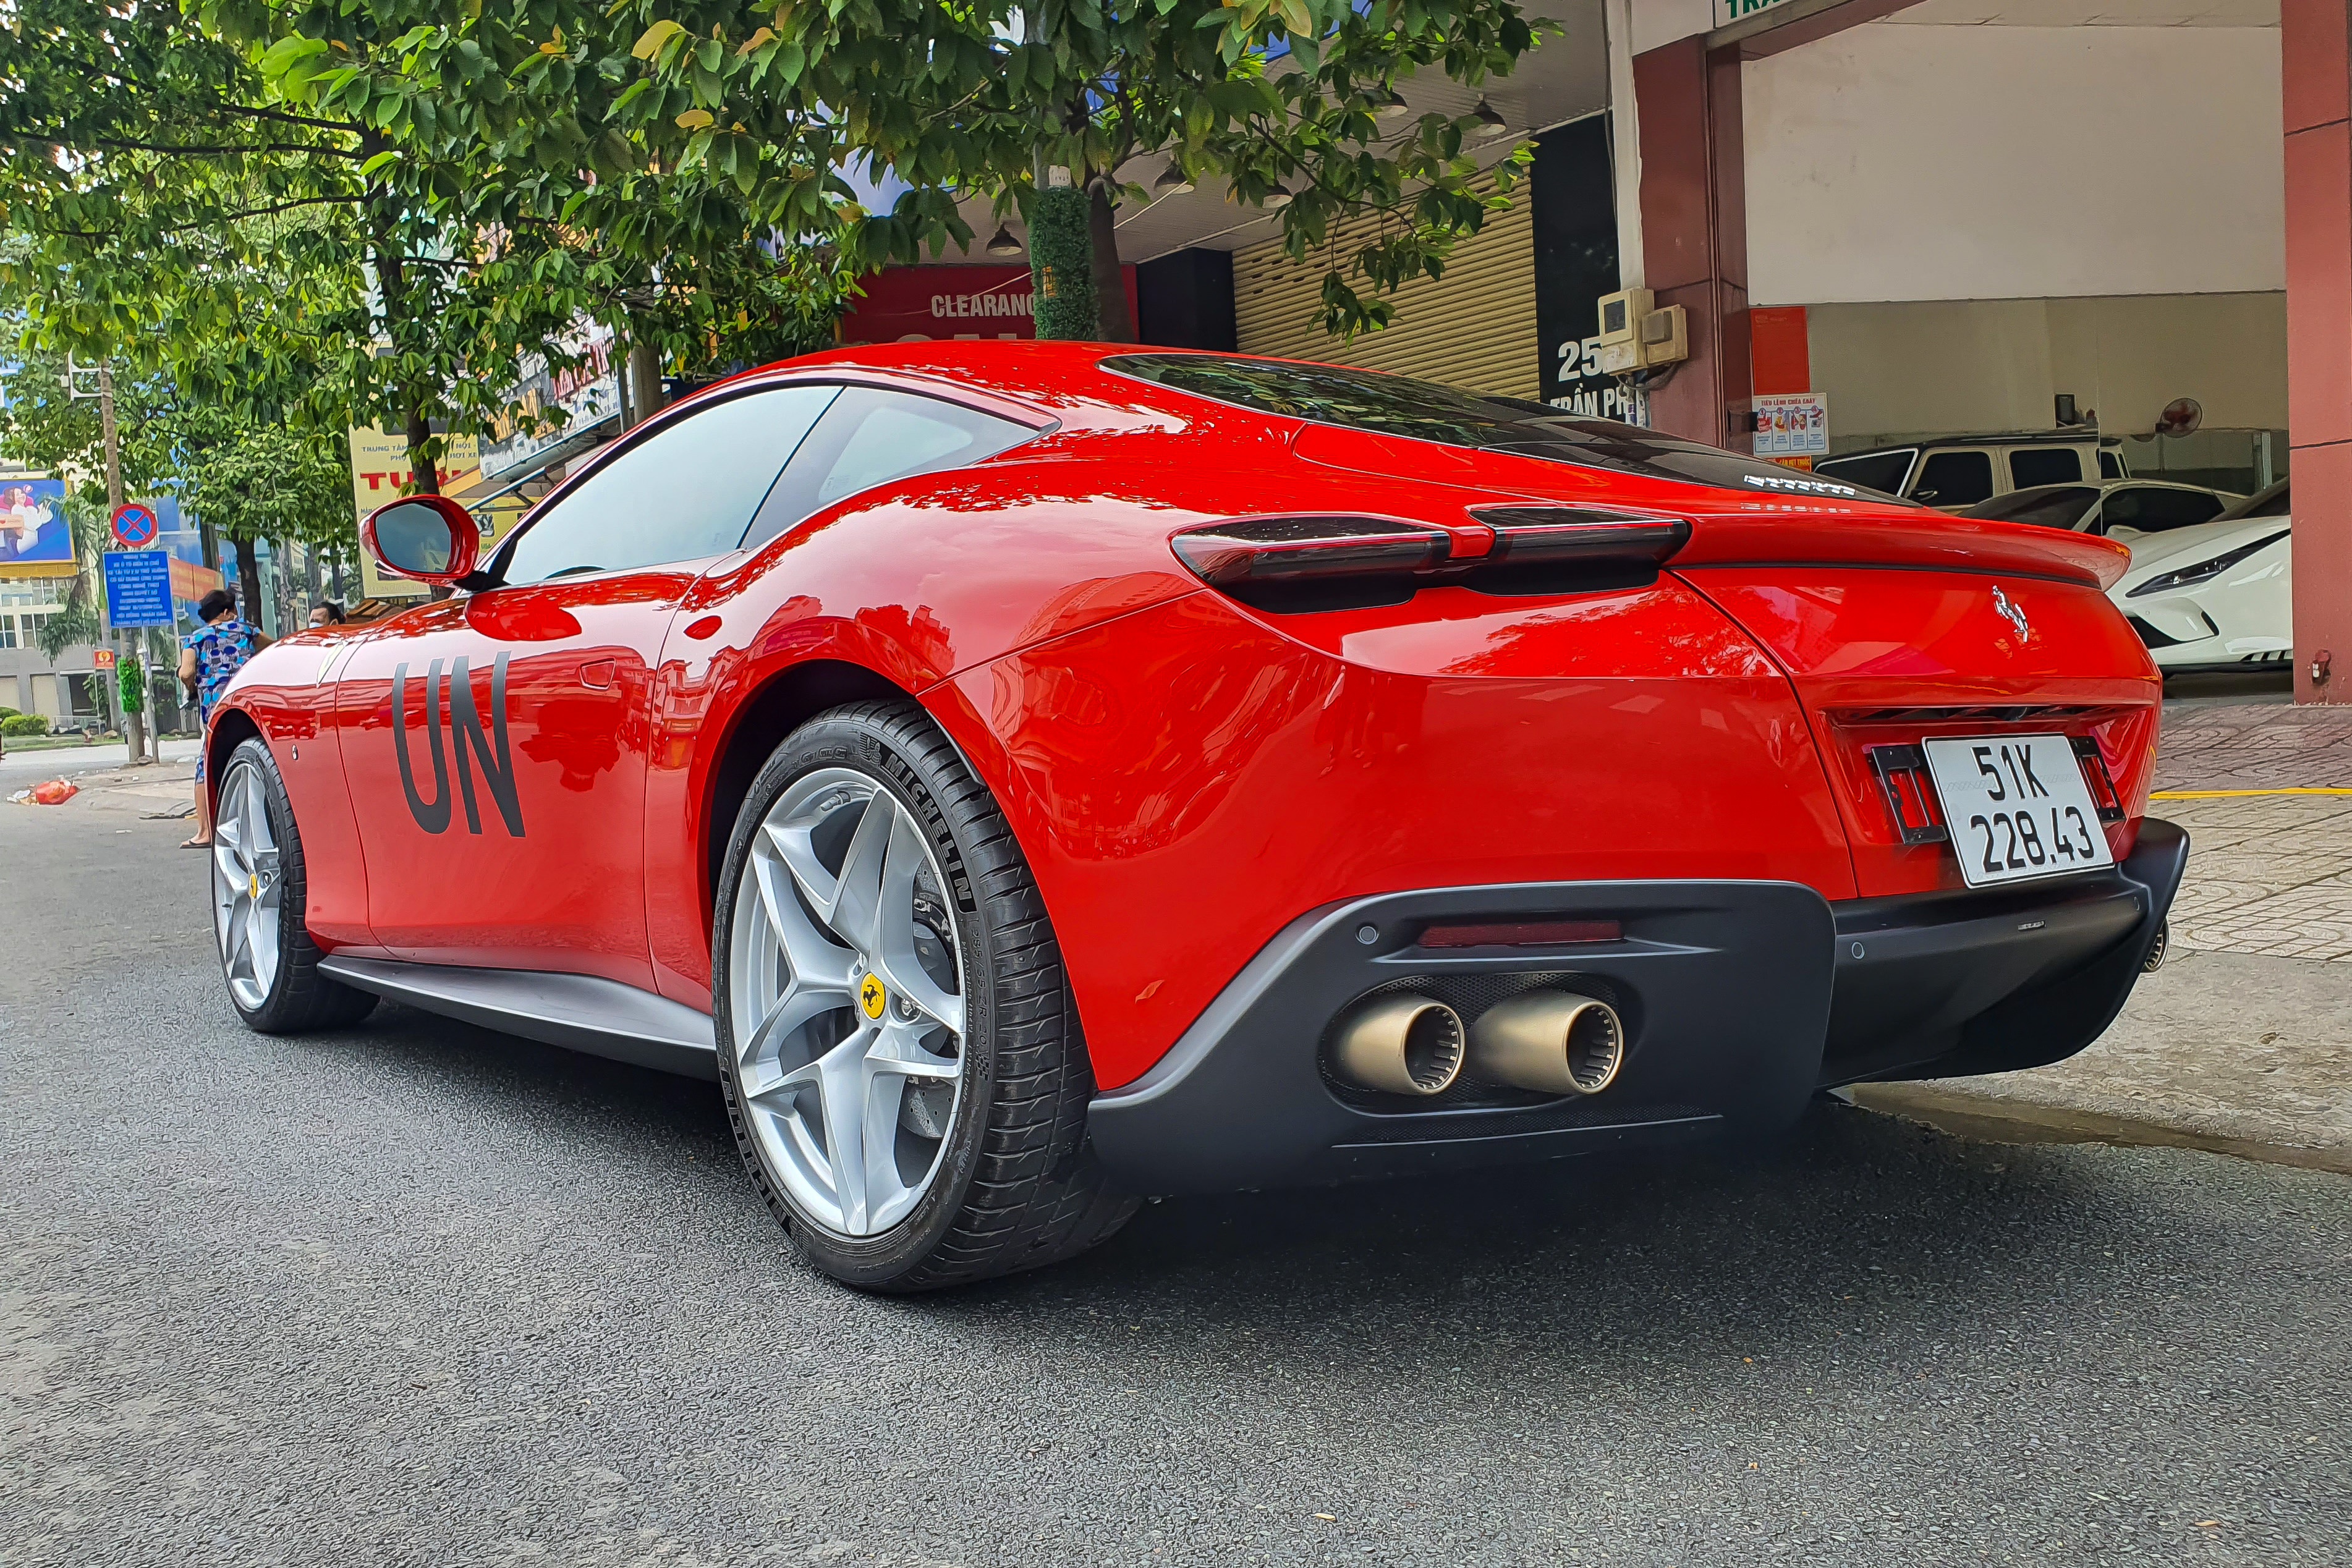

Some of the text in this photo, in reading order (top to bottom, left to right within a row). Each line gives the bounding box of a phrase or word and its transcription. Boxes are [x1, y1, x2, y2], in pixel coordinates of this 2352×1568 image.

[1725, 0, 1781, 19] TR
[931, 294, 1035, 317] CLEARANC
[1550, 383, 1598, 417] RẦN
[393, 651, 526, 837] UN
[1970, 744, 2050, 802] 51K
[885, 753, 972, 901] MICHELIN
[1971, 806, 2094, 873] 228.43
[723, 1080, 786, 1224] MICHELIN
